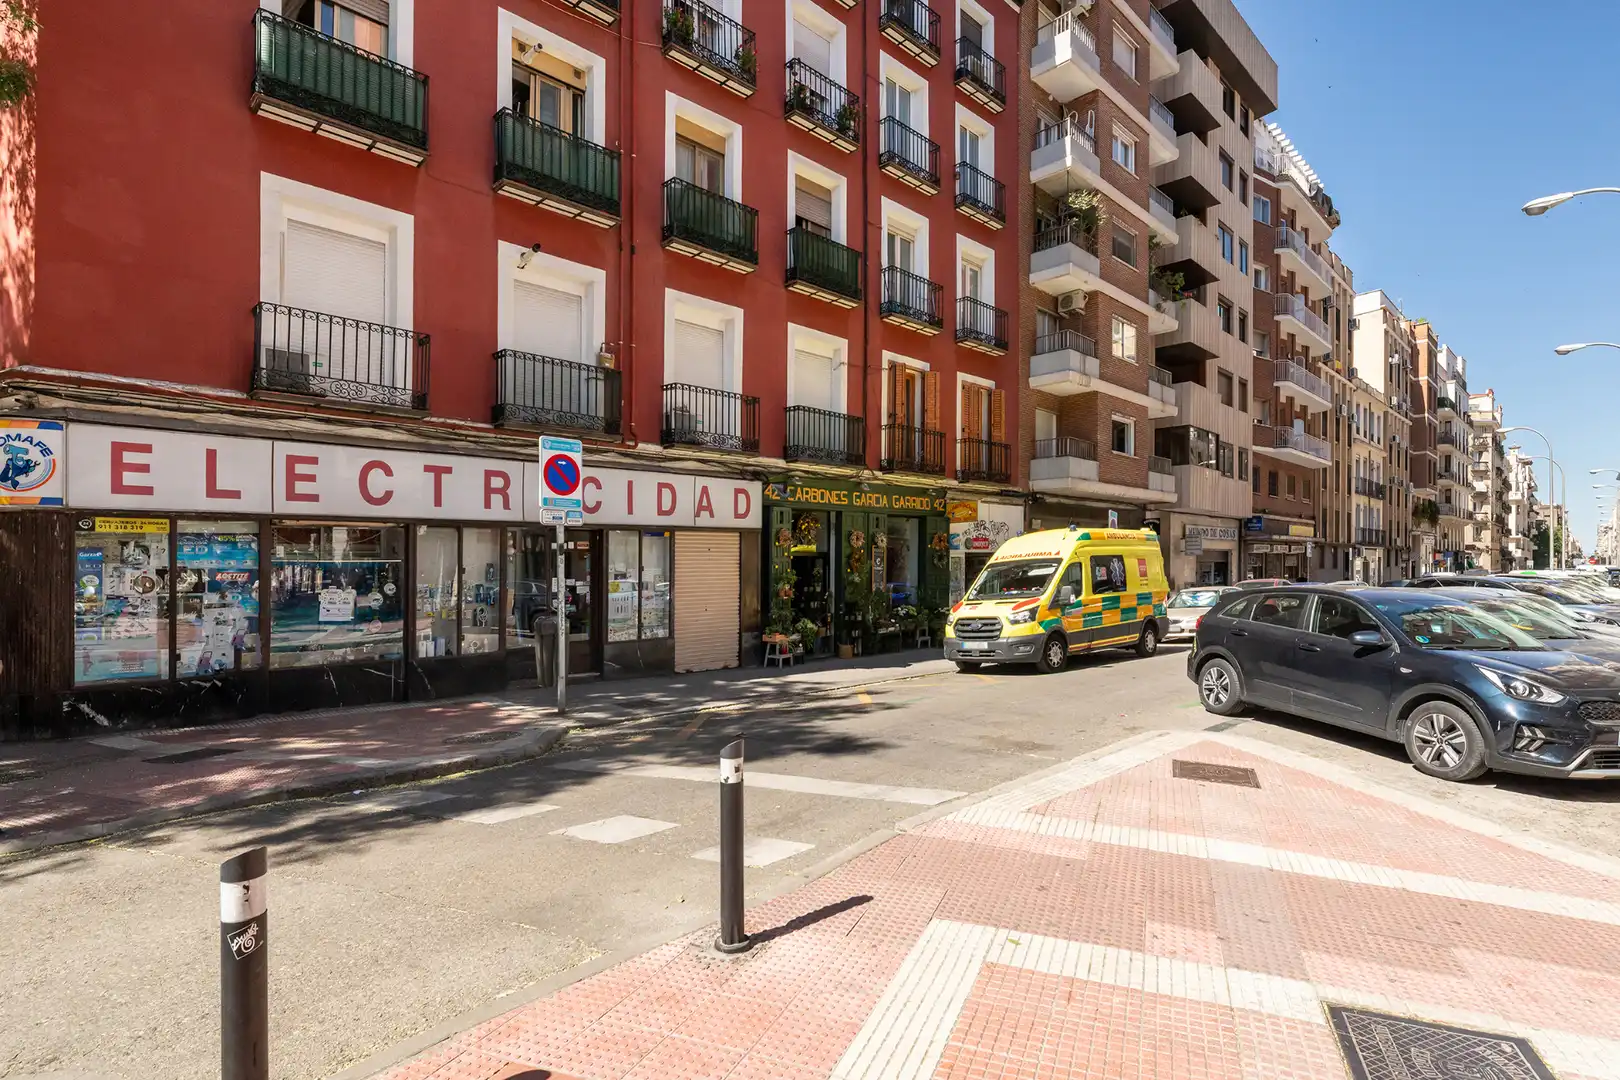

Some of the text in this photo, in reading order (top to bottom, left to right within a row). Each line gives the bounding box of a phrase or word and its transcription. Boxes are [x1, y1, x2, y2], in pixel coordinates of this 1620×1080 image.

[110, 441, 751, 519] ELECTRCIDAD
[787, 486, 848, 505] CARBONES
[893, 496, 930, 510] GARRIDO
[933, 499, 945, 511] 42
[1219, 528, 1236, 538] COSAS
